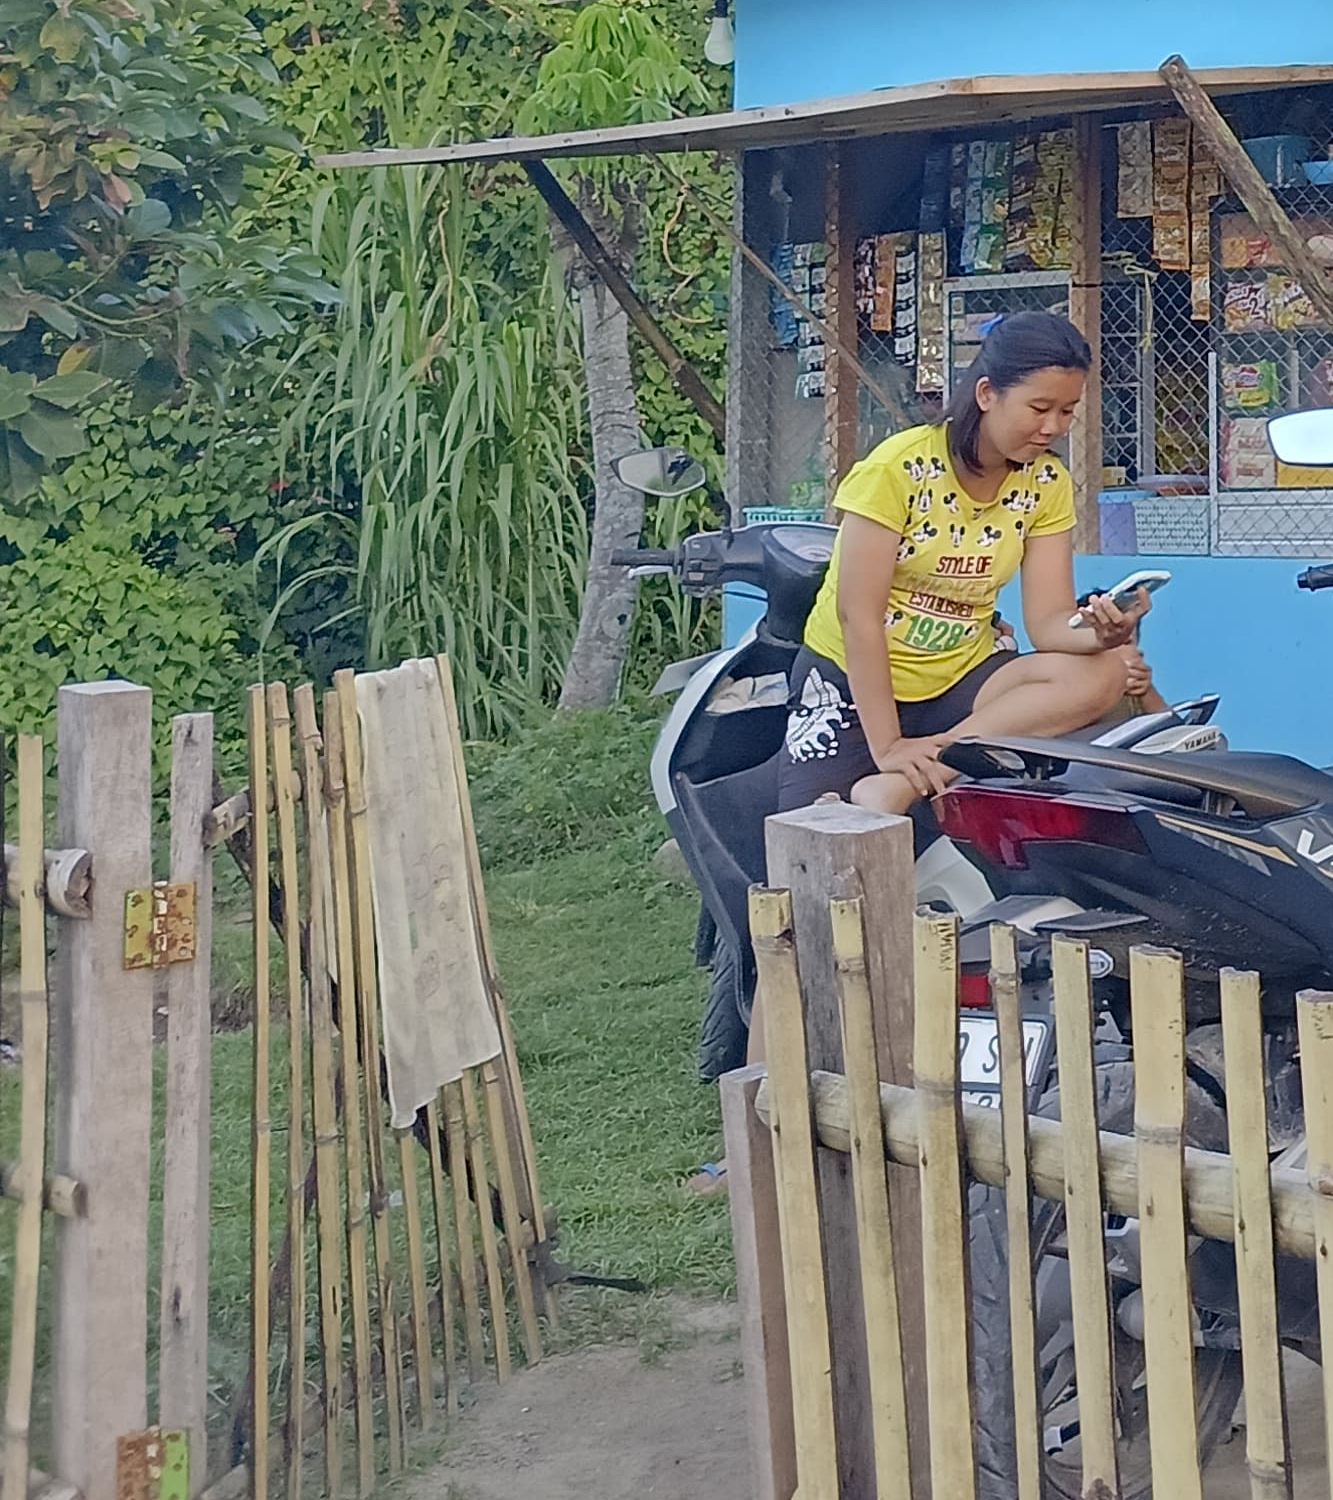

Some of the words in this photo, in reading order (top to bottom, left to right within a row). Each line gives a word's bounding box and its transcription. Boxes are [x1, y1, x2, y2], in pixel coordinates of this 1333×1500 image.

[936, 555, 974, 574] STYLE
[975, 555, 993, 574] OF
[903, 615, 965, 651] 1928
[1184, 731, 1217, 750] YAMAHA
